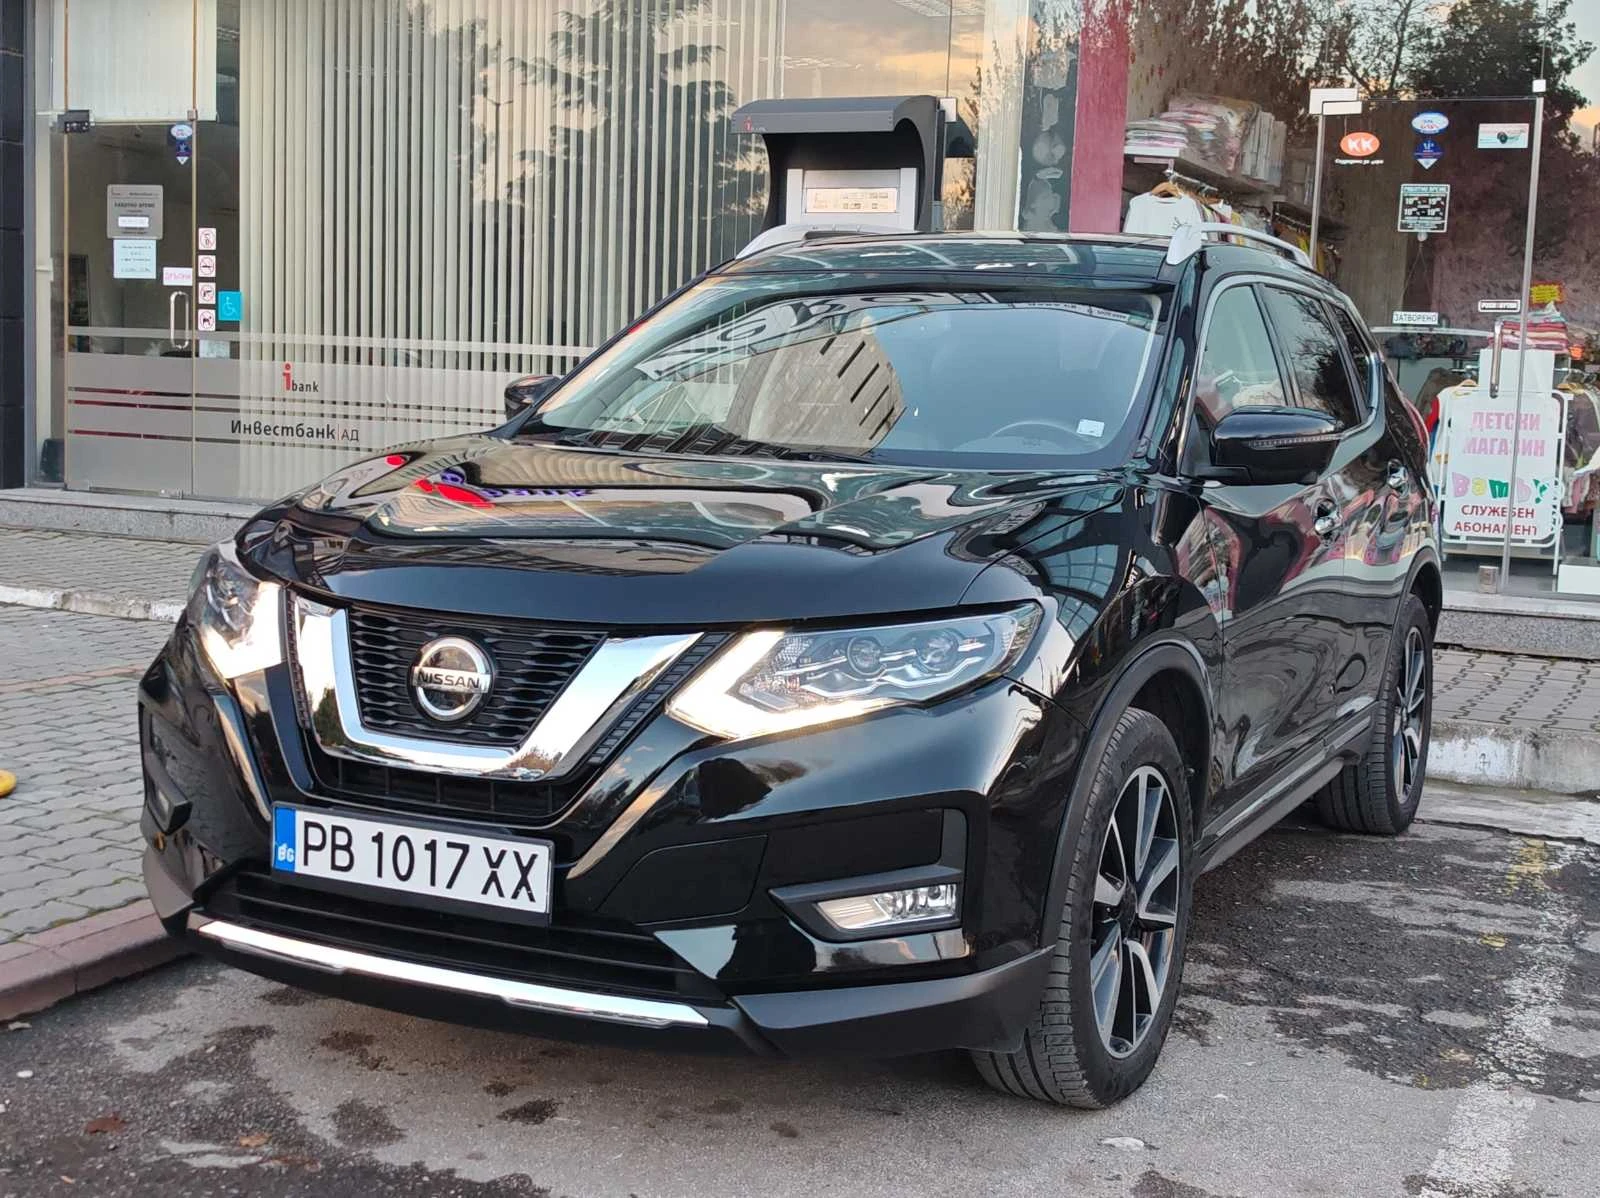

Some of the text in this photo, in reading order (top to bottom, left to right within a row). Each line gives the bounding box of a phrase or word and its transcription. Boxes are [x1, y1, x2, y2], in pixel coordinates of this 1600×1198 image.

[1393, 313, 1437, 322] ЗАТВОРЕНО
[1470, 411, 1541, 431] ДЕТСКИ
[231, 420, 360, 442] Инвестбанк АД
[1461, 505, 1535, 518] СЛУЖЕБЕН
[418, 670, 480, 689] NISSAN
[277, 844, 295, 863] BG
[303, 820, 539, 904] PB 1017 XX
